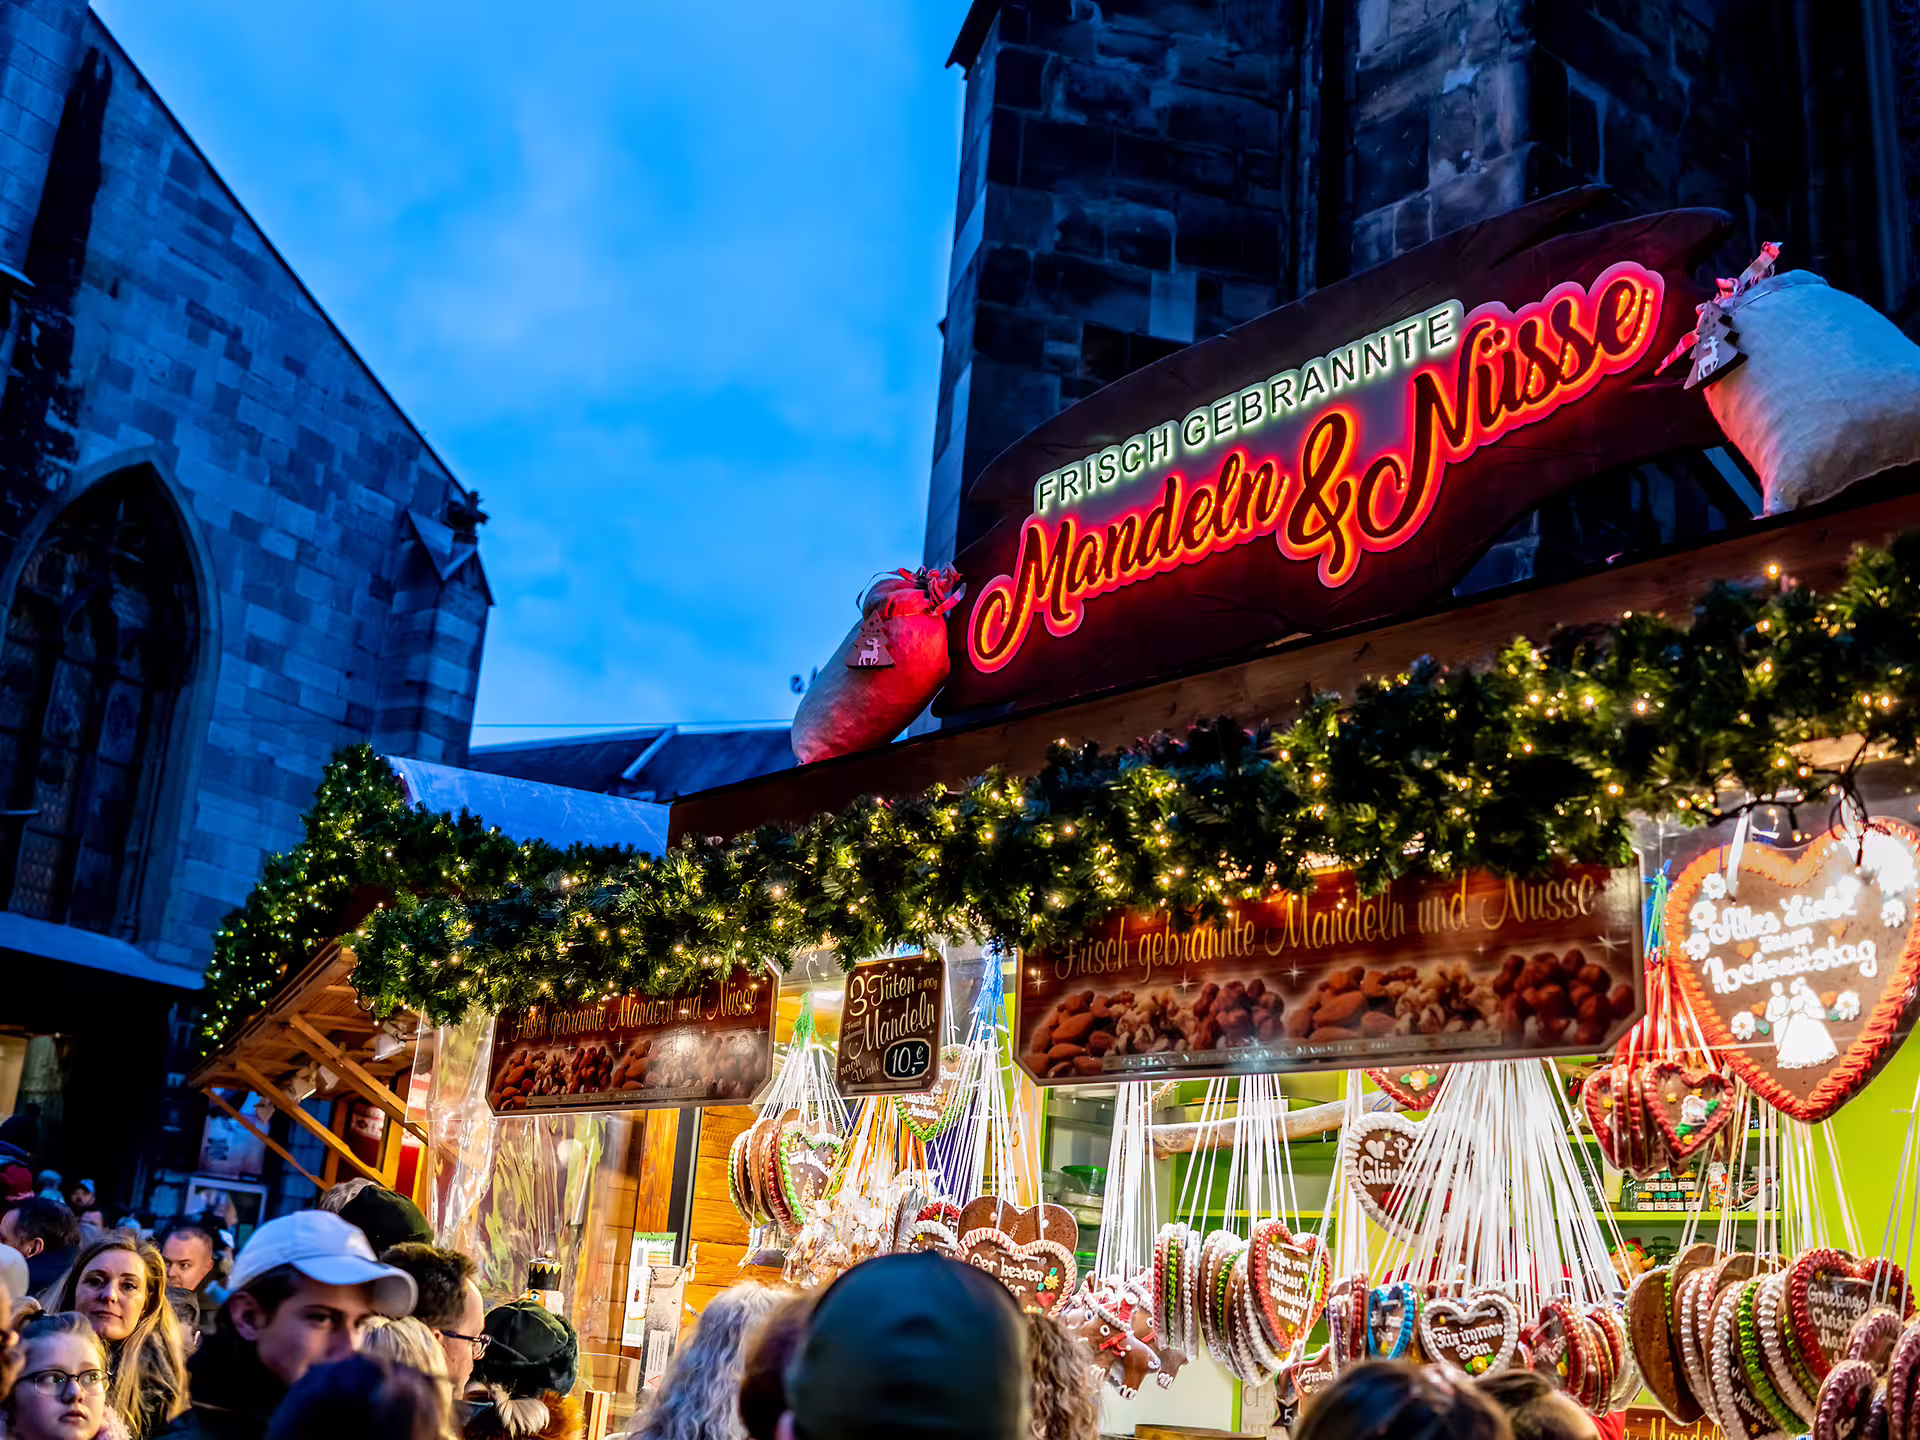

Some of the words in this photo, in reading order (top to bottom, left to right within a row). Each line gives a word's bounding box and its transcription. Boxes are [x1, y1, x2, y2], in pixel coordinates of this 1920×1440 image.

[1038, 426, 1169, 511] FRISCH
[1183, 308, 1452, 447] GEBRANNTE
[974, 451, 1289, 660] Mandeln
[1287, 411, 1355, 576] &
[1356, 277, 1650, 539] Nüsse
[1138, 909, 1255, 983] gebrannte
[1264, 880, 1406, 956] Mandeln
[1418, 868, 1469, 931] und
[848, 991, 936, 1060] Mandeln
[849, 975, 868, 1017] 3
[866, 971, 916, 1007] Tüten
[1000, 1256, 1044, 1283] besten
